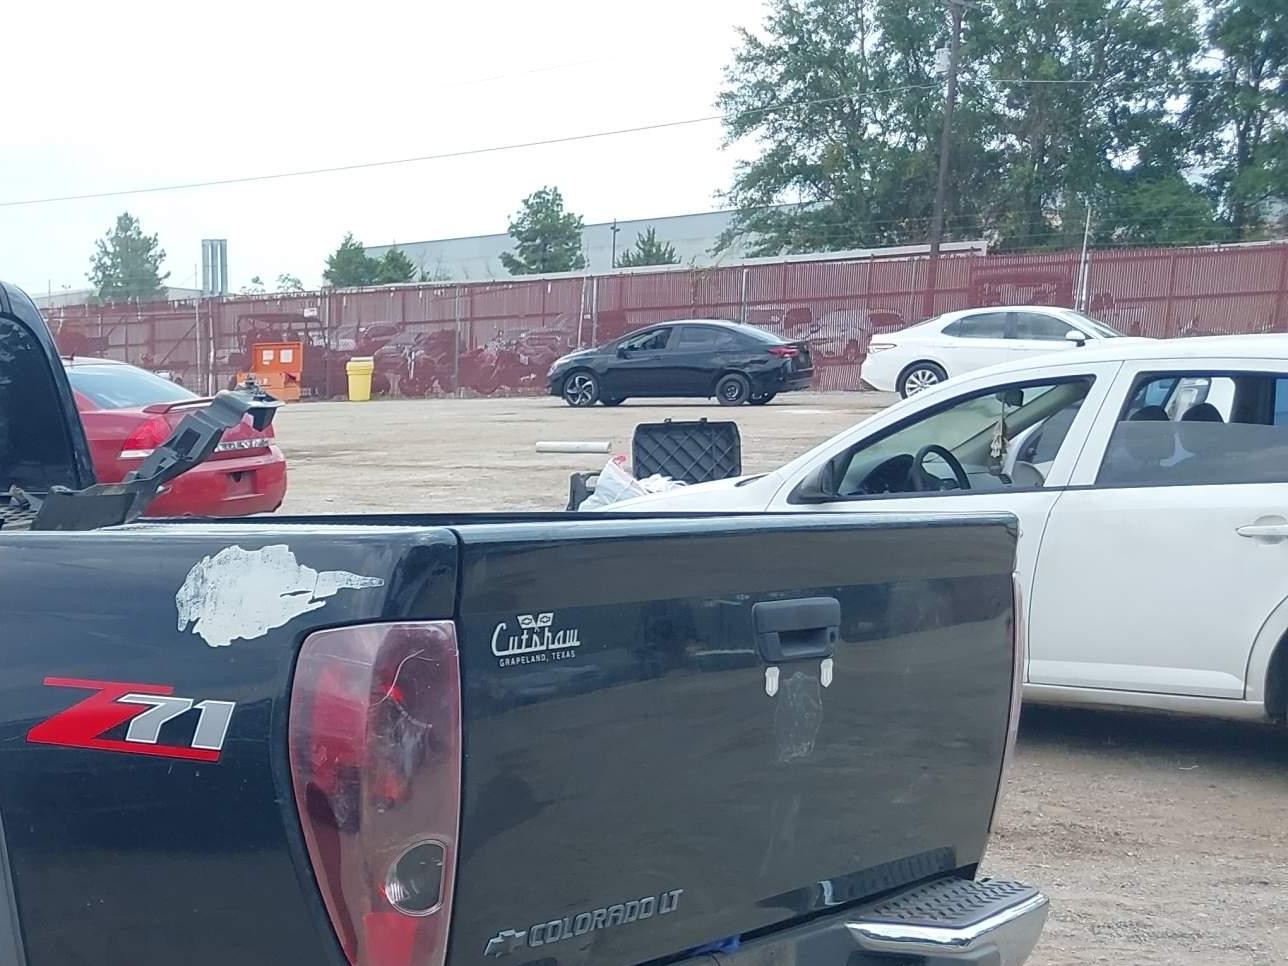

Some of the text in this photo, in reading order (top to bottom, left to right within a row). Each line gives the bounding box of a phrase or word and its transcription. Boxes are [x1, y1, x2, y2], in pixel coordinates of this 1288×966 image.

[491, 622, 581, 656] Cutshaw
[499, 650, 576, 667] GRAPELAND, TEXAS
[26, 676, 237, 762] Z71
[529, 889, 684, 947] COLORADO LT
